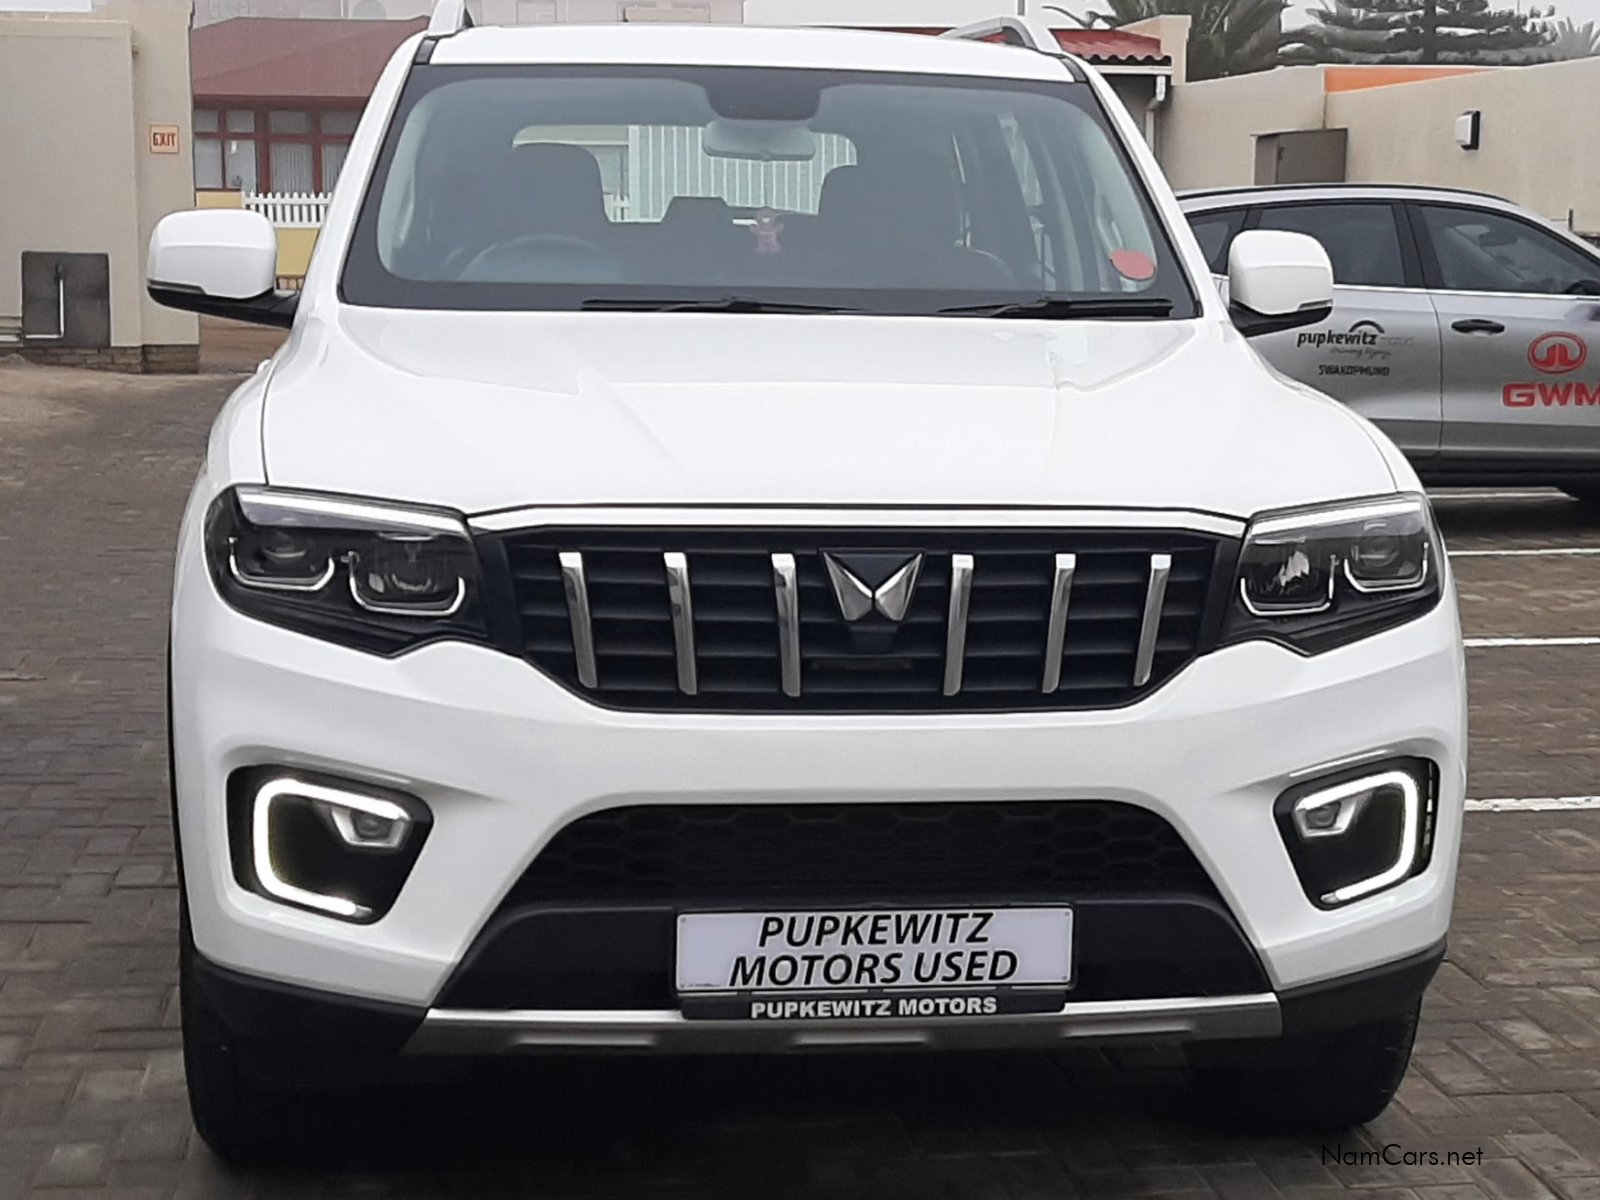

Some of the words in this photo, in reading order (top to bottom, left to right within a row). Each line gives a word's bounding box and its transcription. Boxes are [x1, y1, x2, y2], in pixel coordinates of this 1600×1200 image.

[153, 132, 175, 146] EXIT
[1297, 329, 1377, 348] pupkewitz
[1318, 365, 1389, 376] SWAKOPMUND
[1502, 382, 1600, 408] GWM
[758, 912, 994, 947] PUPKEWITZ
[729, 952, 902, 987] MOTORS
[914, 950, 1018, 982] USED
[751, 999, 891, 1019] PUPKEWITZ
[898, 996, 997, 1015] MOTORS
